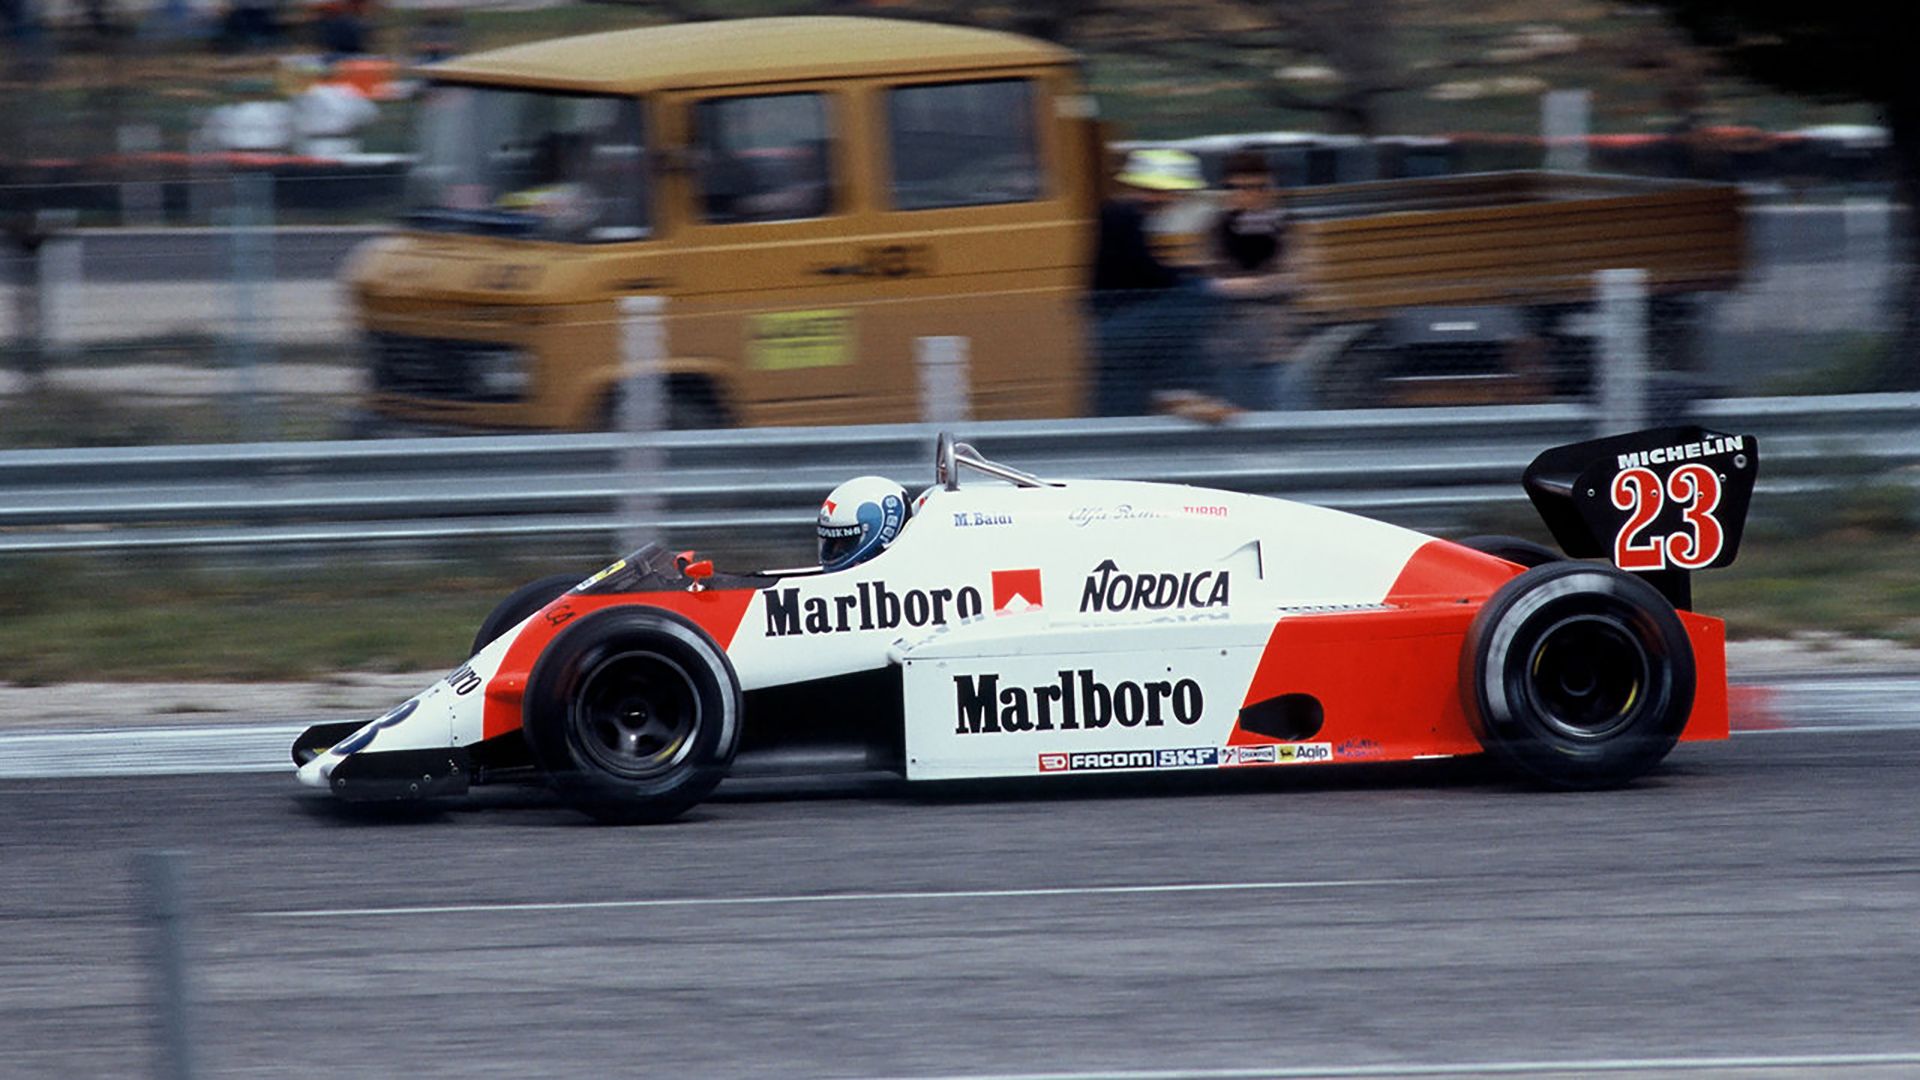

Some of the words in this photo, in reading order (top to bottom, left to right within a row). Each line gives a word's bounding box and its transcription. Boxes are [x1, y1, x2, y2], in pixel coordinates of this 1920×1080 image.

[1617, 435, 1744, 469] MICHELIN
[1611, 463, 1724, 571] 23
[764, 580, 984, 637] Marlboro
[1079, 561, 1230, 613] NORDICA
[953, 669, 1204, 735] Marlboro
[1071, 752, 1152, 768] FACOM
[1158, 748, 1214, 766] SKF
[1296, 745, 1329, 760] Agip
